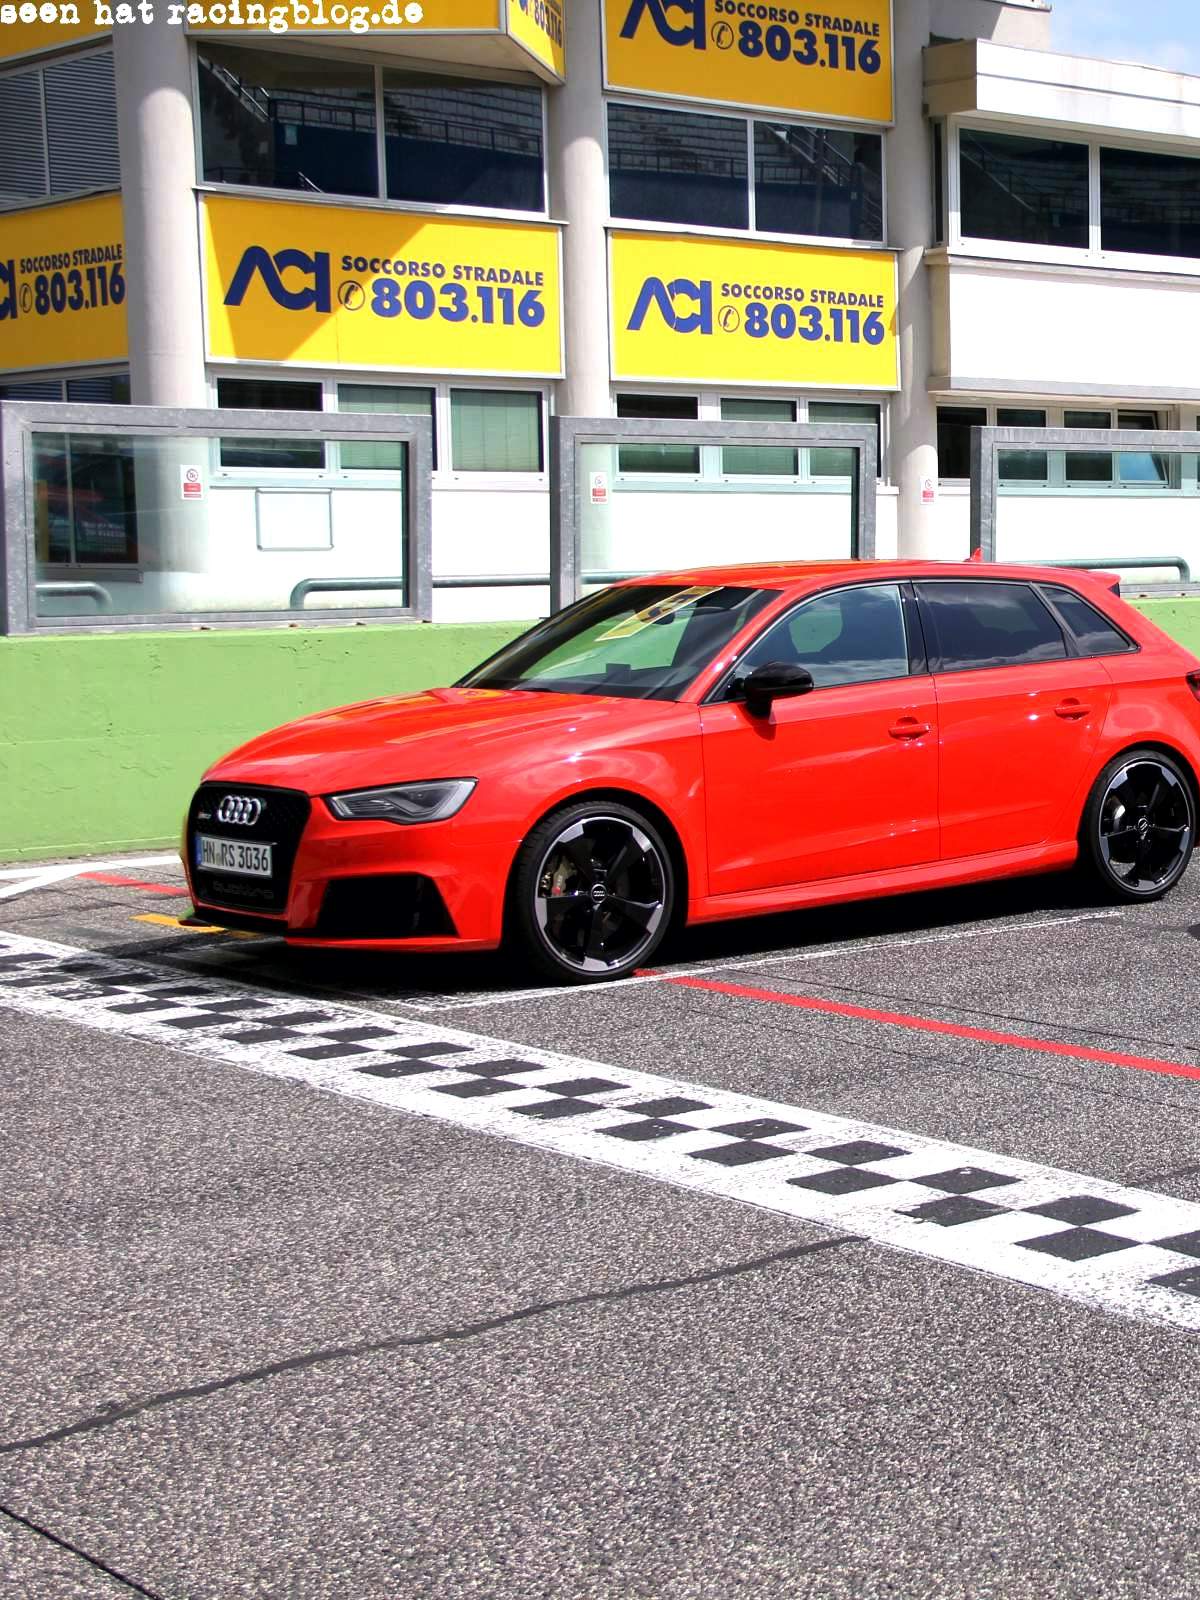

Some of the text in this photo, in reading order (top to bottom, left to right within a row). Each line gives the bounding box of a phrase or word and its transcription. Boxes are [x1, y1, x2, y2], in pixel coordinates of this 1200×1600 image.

[715, 0, 880, 37] SOCCORSO STRADALE
[738, 20, 881, 75] 803.116
[20, 243, 122, 274] SOCCORSO STRADALE
[224, 246, 332, 313] ACI
[342, 255, 544, 287] SOCCORSO STRADALE
[34, 262, 126, 316] 803.116
[371, 277, 546, 328] 803.116
[626, 276, 713, 335] ACI
[721, 282, 884, 308] SOCCORSO STRADALE
[744, 302, 885, 346] 803.116
[203, 841, 268, 872] HN RS 3036
